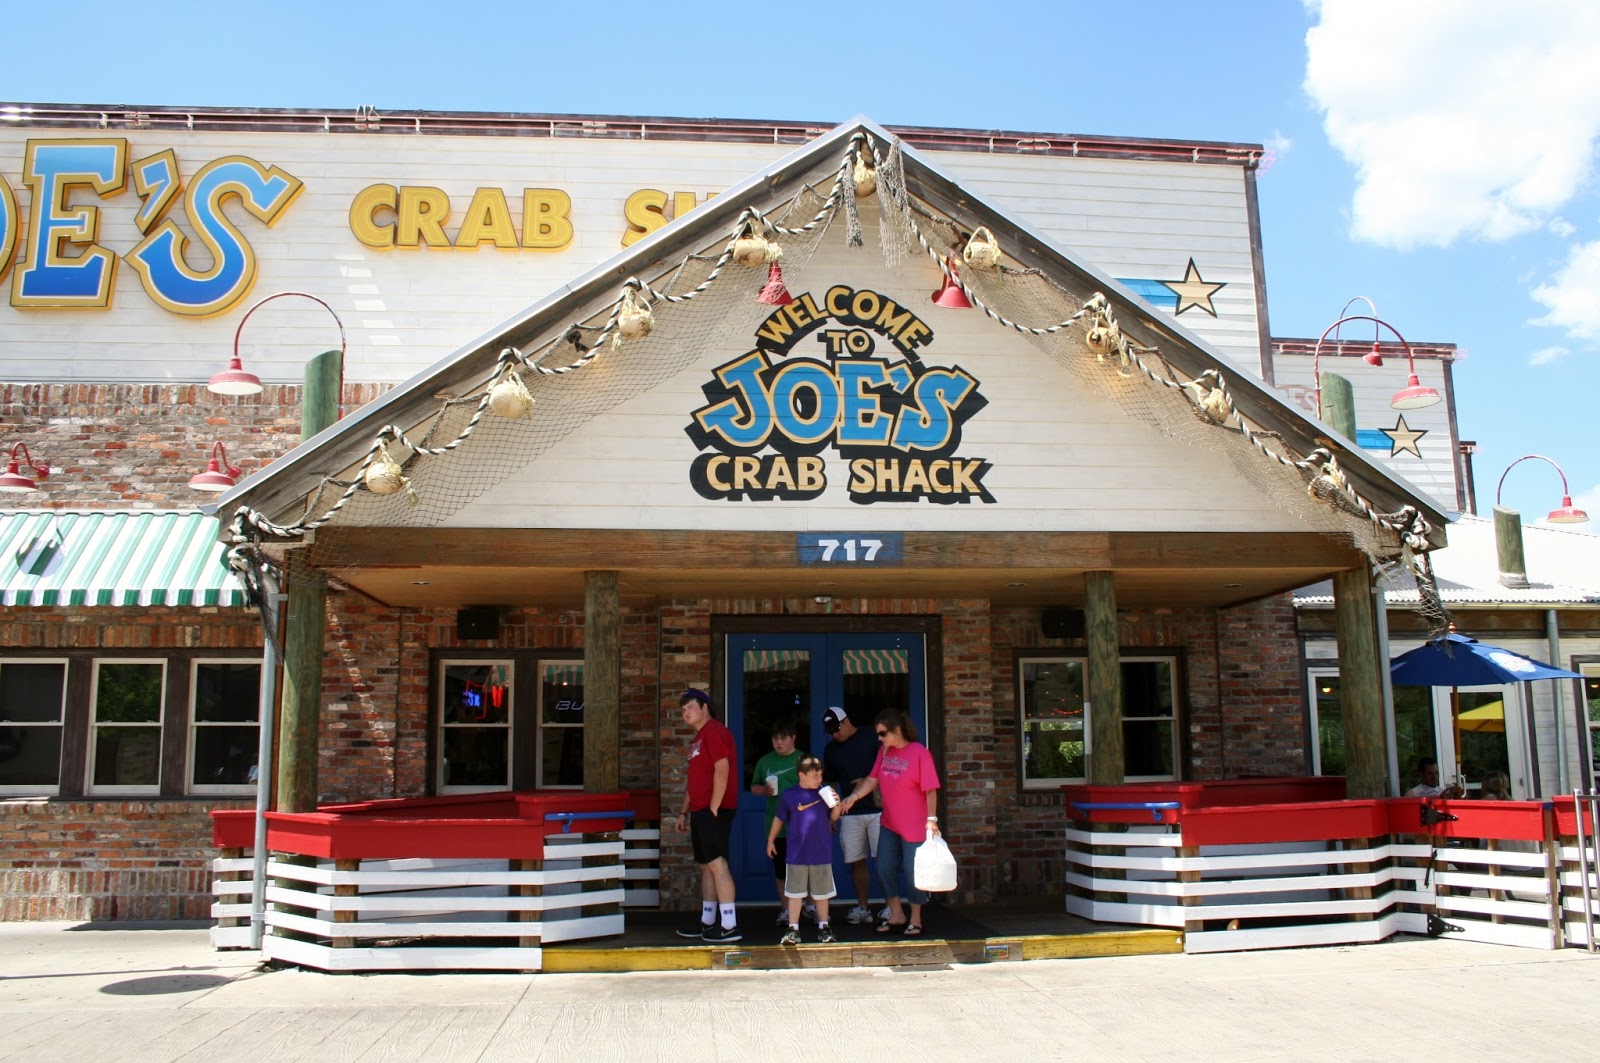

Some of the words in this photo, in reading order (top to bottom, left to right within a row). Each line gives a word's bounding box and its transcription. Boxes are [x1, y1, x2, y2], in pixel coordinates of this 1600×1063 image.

[0, 138, 304, 318] E'S
[349, 183, 575, 252] CRAB
[755, 286, 932, 354] WELCOME
[822, 329, 873, 356] TO
[692, 350, 980, 454] JOE'S
[699, 455, 827, 495] CRAB
[850, 457, 988, 497] SHACK
[818, 539, 883, 562] 717
